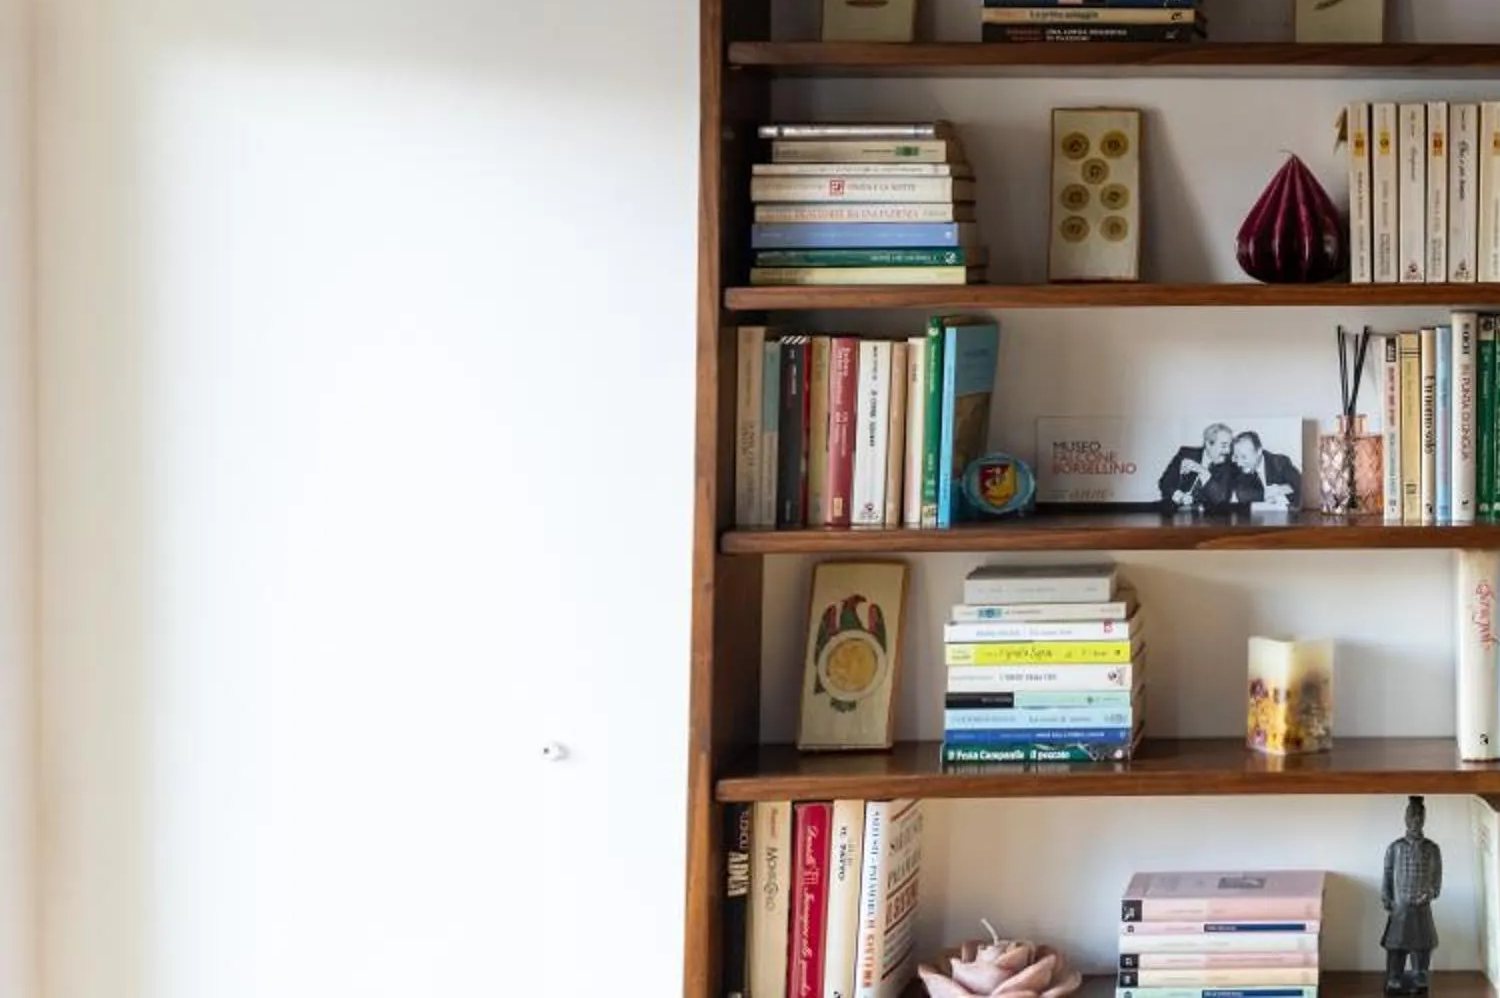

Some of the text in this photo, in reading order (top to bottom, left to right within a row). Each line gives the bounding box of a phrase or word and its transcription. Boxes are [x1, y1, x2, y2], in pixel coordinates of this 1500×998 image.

[1052, 441, 1101, 453] MUSEO
[1052, 452, 1117, 462] FALCONE
[1052, 462, 1138, 475] BORSELLINO
